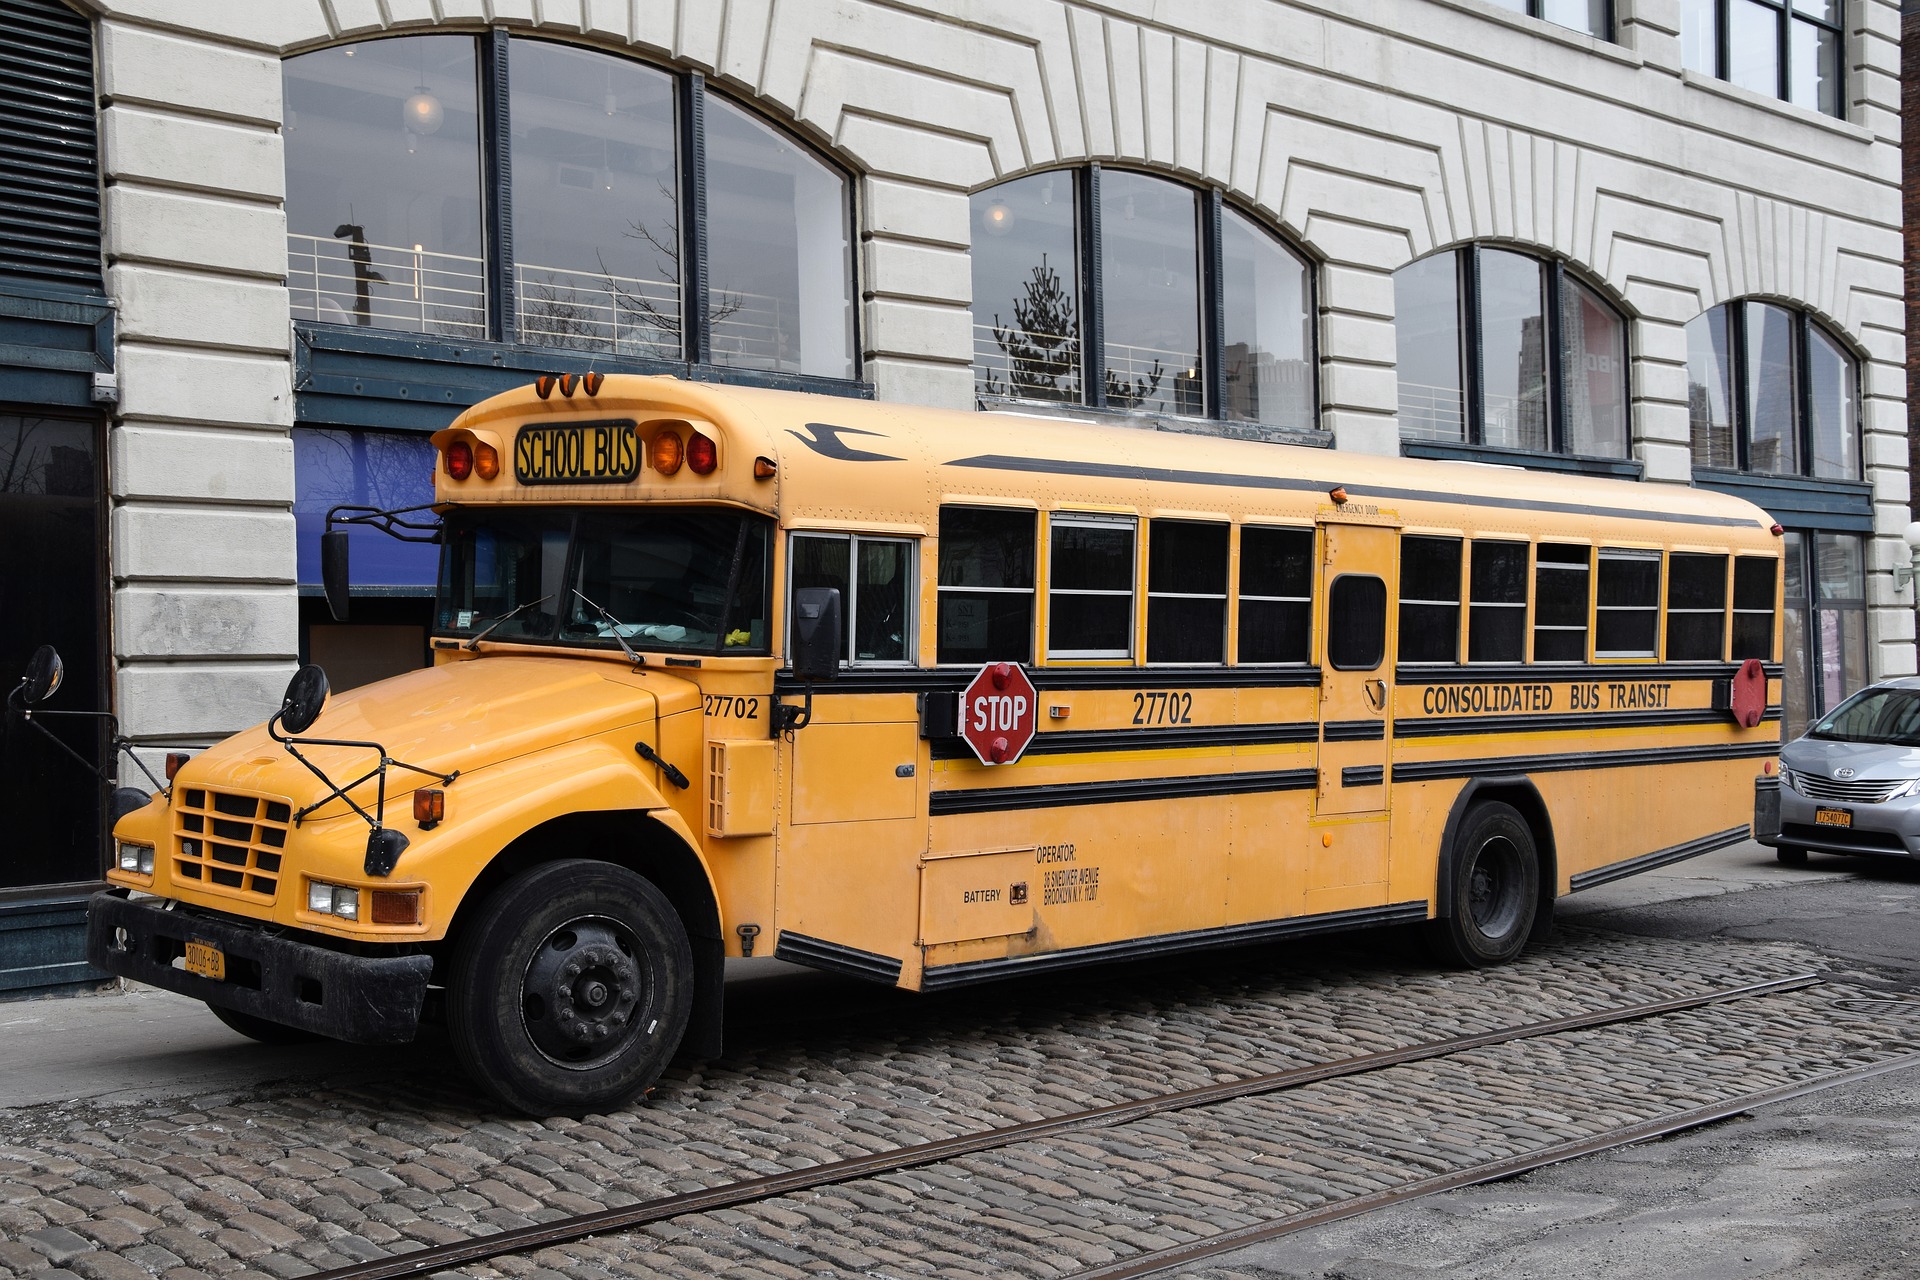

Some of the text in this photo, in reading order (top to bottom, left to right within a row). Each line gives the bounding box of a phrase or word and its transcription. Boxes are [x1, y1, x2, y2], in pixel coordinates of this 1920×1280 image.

[519, 426, 635, 478] SCHOOL BUS
[704, 695, 759, 719] 27702
[1132, 692, 1192, 725] 27702
[1423, 683, 1672, 715] CONSOLIDATED BUS TRANSIT
[973, 695, 1027, 732] STOP
[1036, 844, 1077, 864] OPERATOR:
[1079, 867, 1100, 885] AVENUE
[964, 889, 1001, 903] BATTERY
[1044, 887, 1072, 906] BROOKLYN
